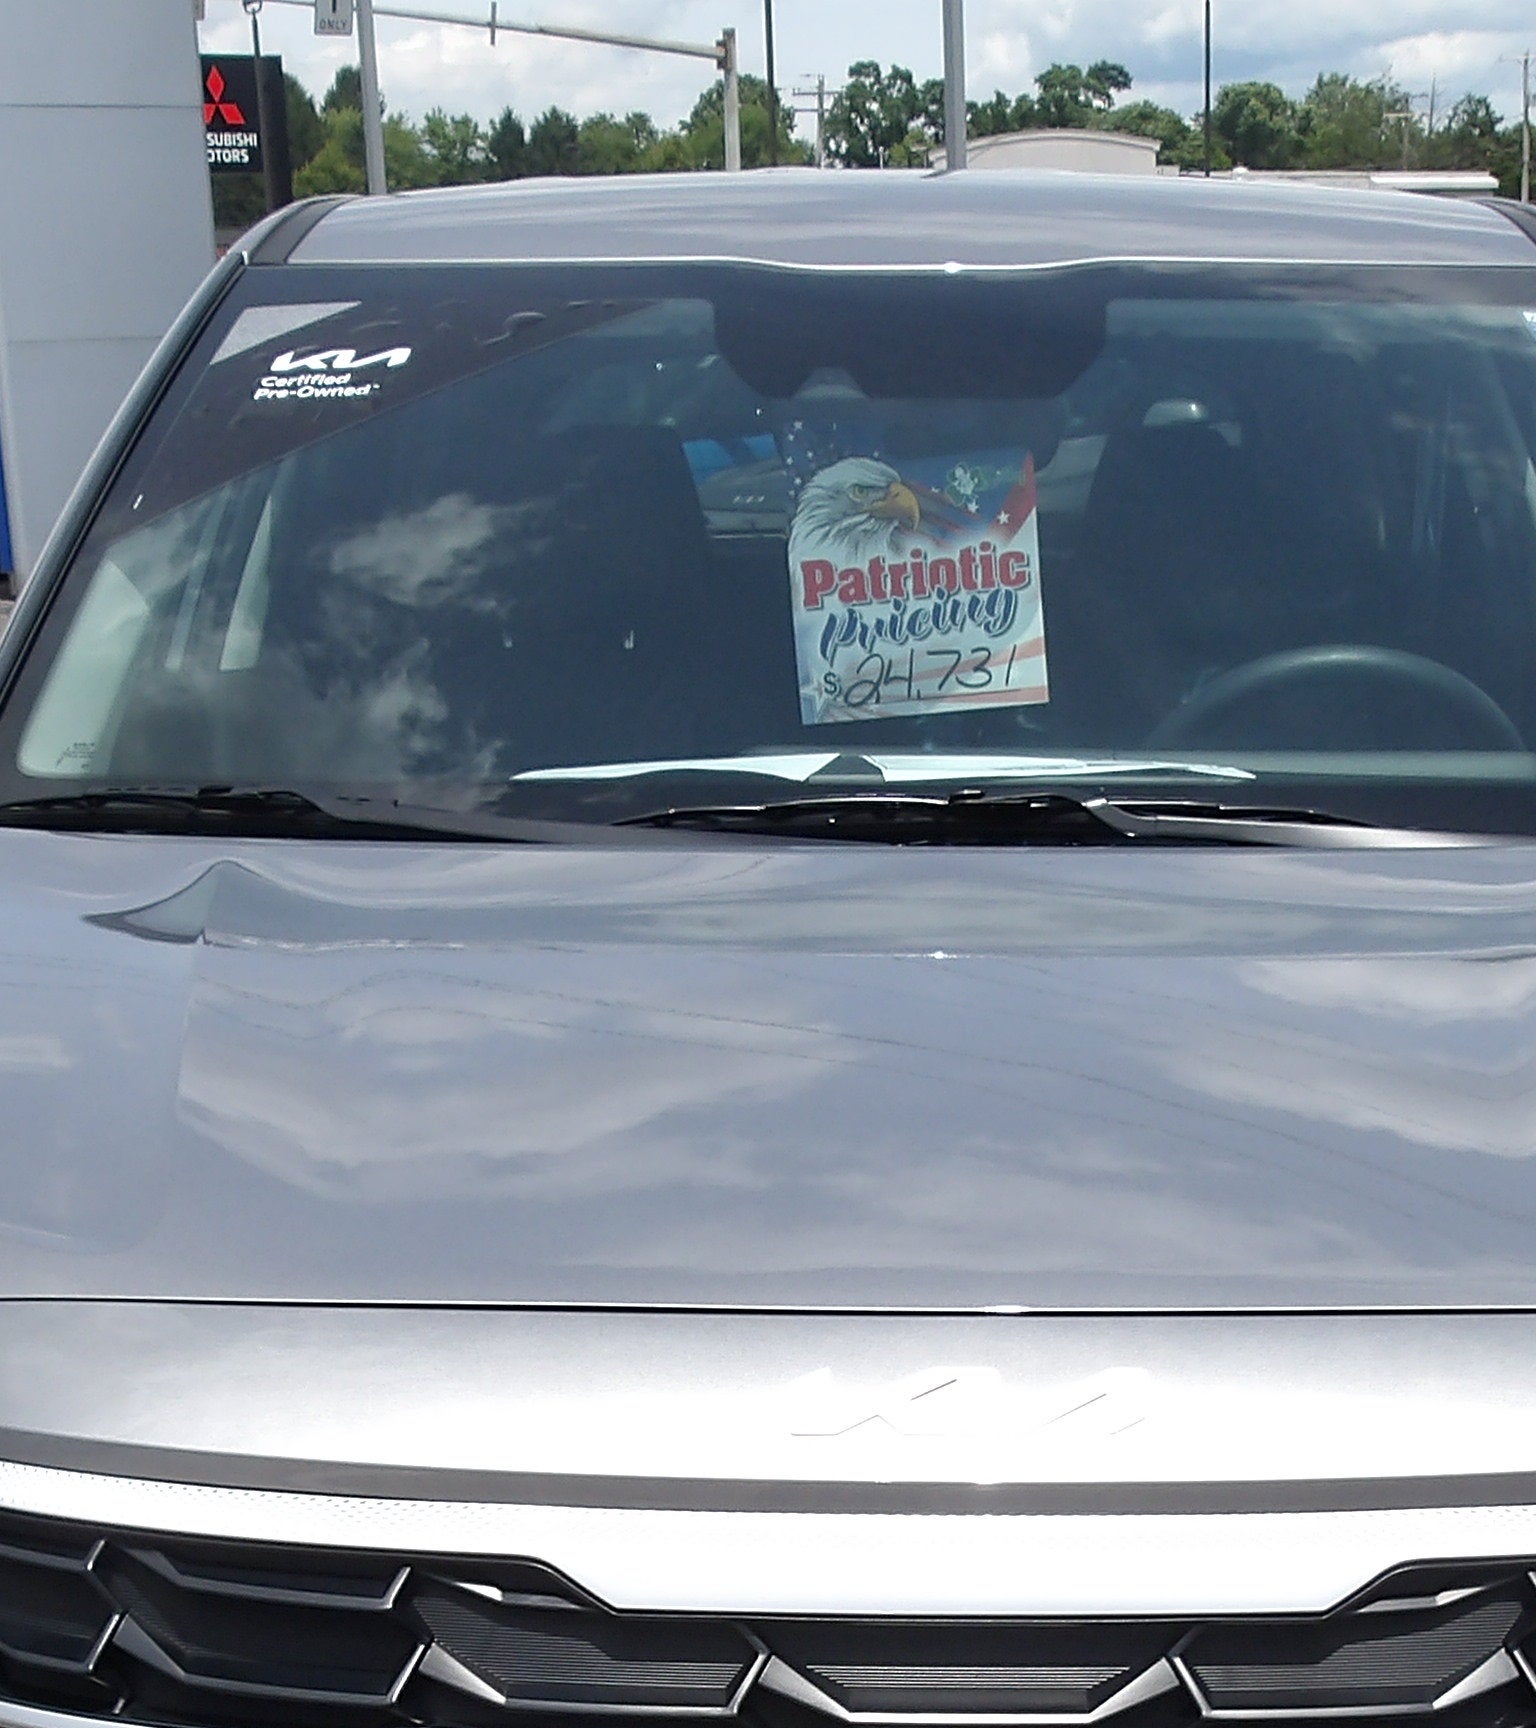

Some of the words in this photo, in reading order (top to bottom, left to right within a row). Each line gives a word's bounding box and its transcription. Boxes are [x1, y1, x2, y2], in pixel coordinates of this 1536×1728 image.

[318, 19, 348, 31] ONLY
[206, 132, 258, 148] SUBISHI
[208, 148, 250, 163] OTORS
[260, 373, 352, 388] Certified
[799, 541, 1032, 611] Patriotic
